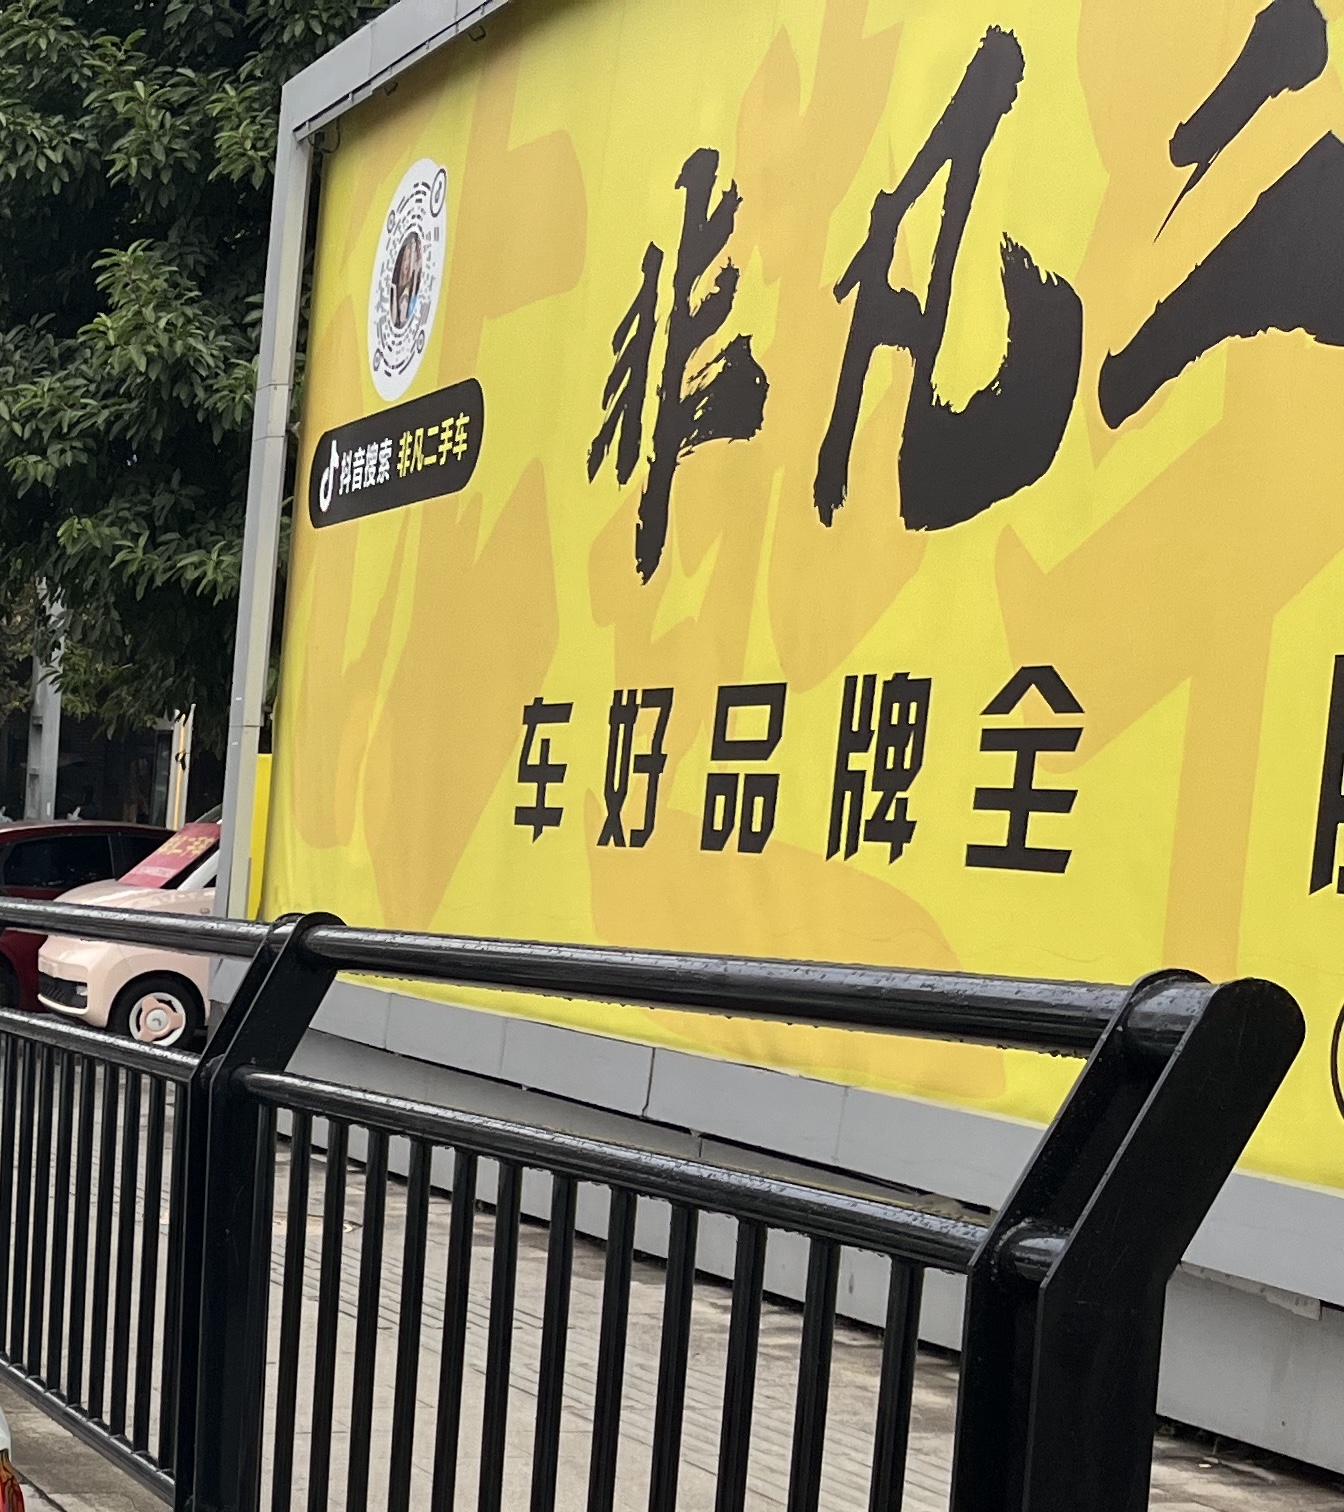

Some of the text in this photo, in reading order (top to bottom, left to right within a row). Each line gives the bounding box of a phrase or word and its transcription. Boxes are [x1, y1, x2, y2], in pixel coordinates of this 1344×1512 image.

[338, 411, 470, 495] 抖音搜索 非凡二手车
[514, 665, 1085, 874] 车好品牌全
